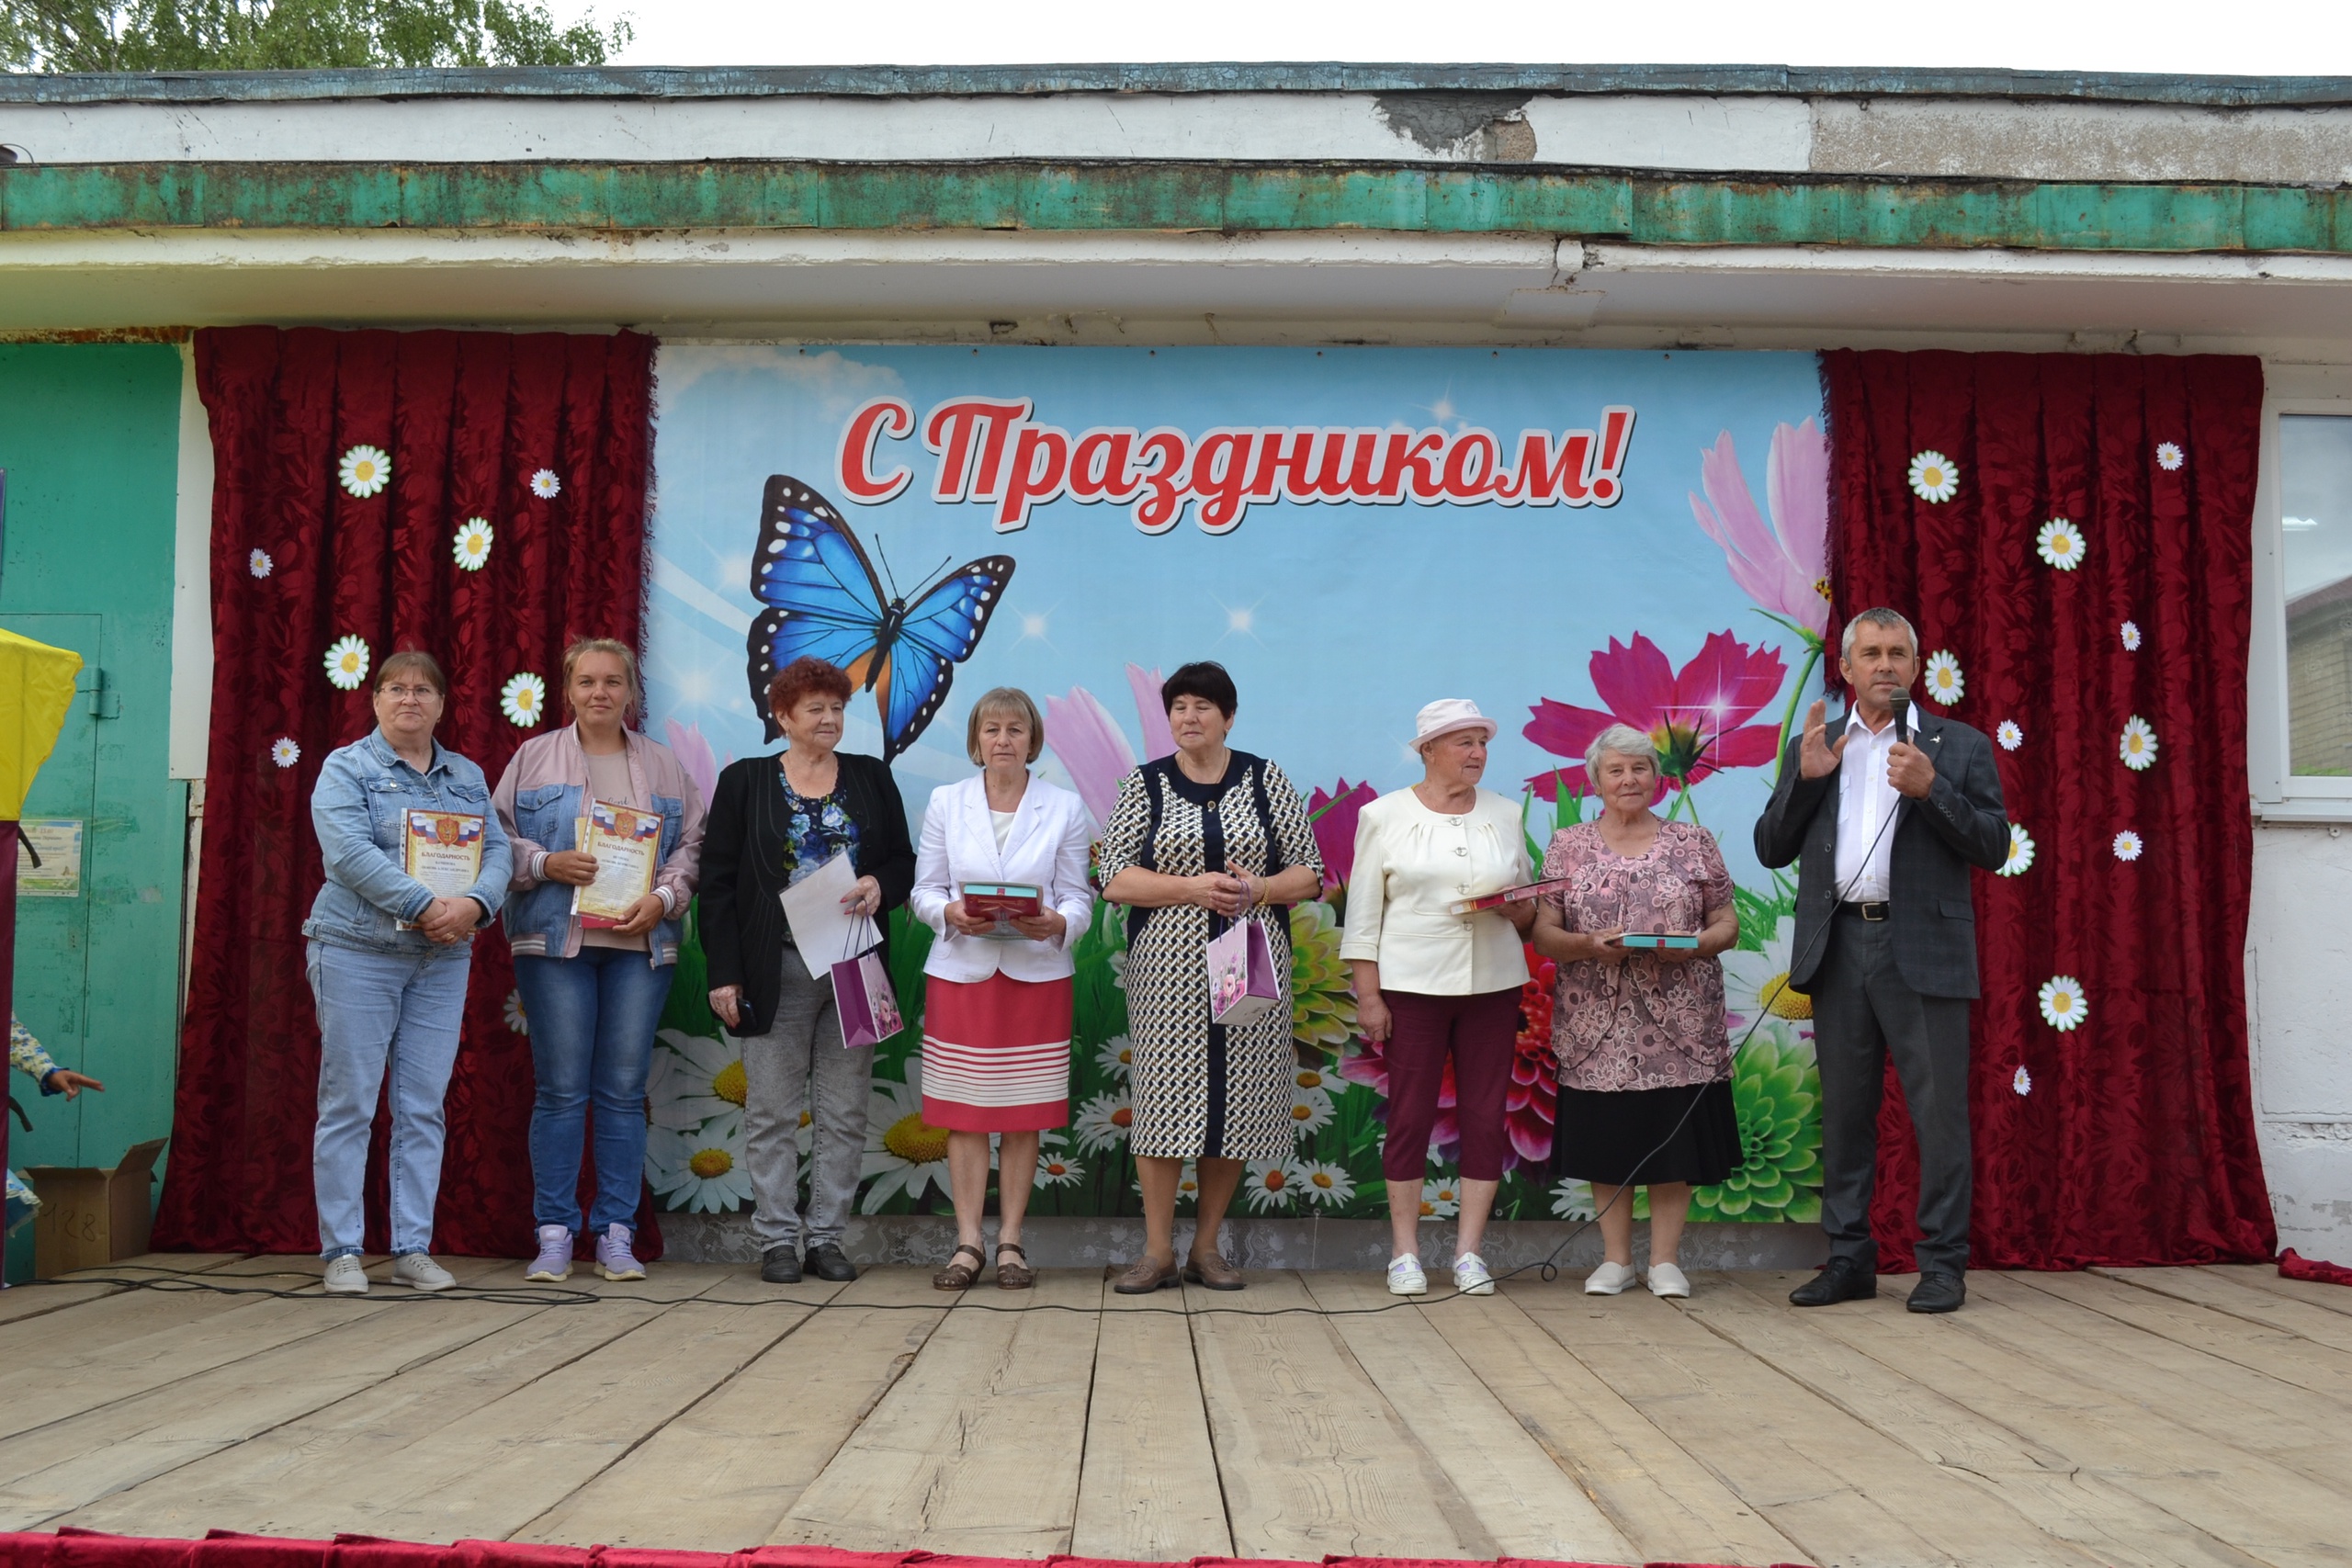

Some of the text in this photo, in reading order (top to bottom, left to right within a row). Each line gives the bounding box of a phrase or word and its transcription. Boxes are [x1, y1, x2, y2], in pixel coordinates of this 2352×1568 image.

[840, 400, 1629, 528] С Праздником!
[597, 840, 645, 856] БЛАГОДАРНОСТЬ
[421, 852, 471, 862] БЛАГОДАРНОСТЬ
